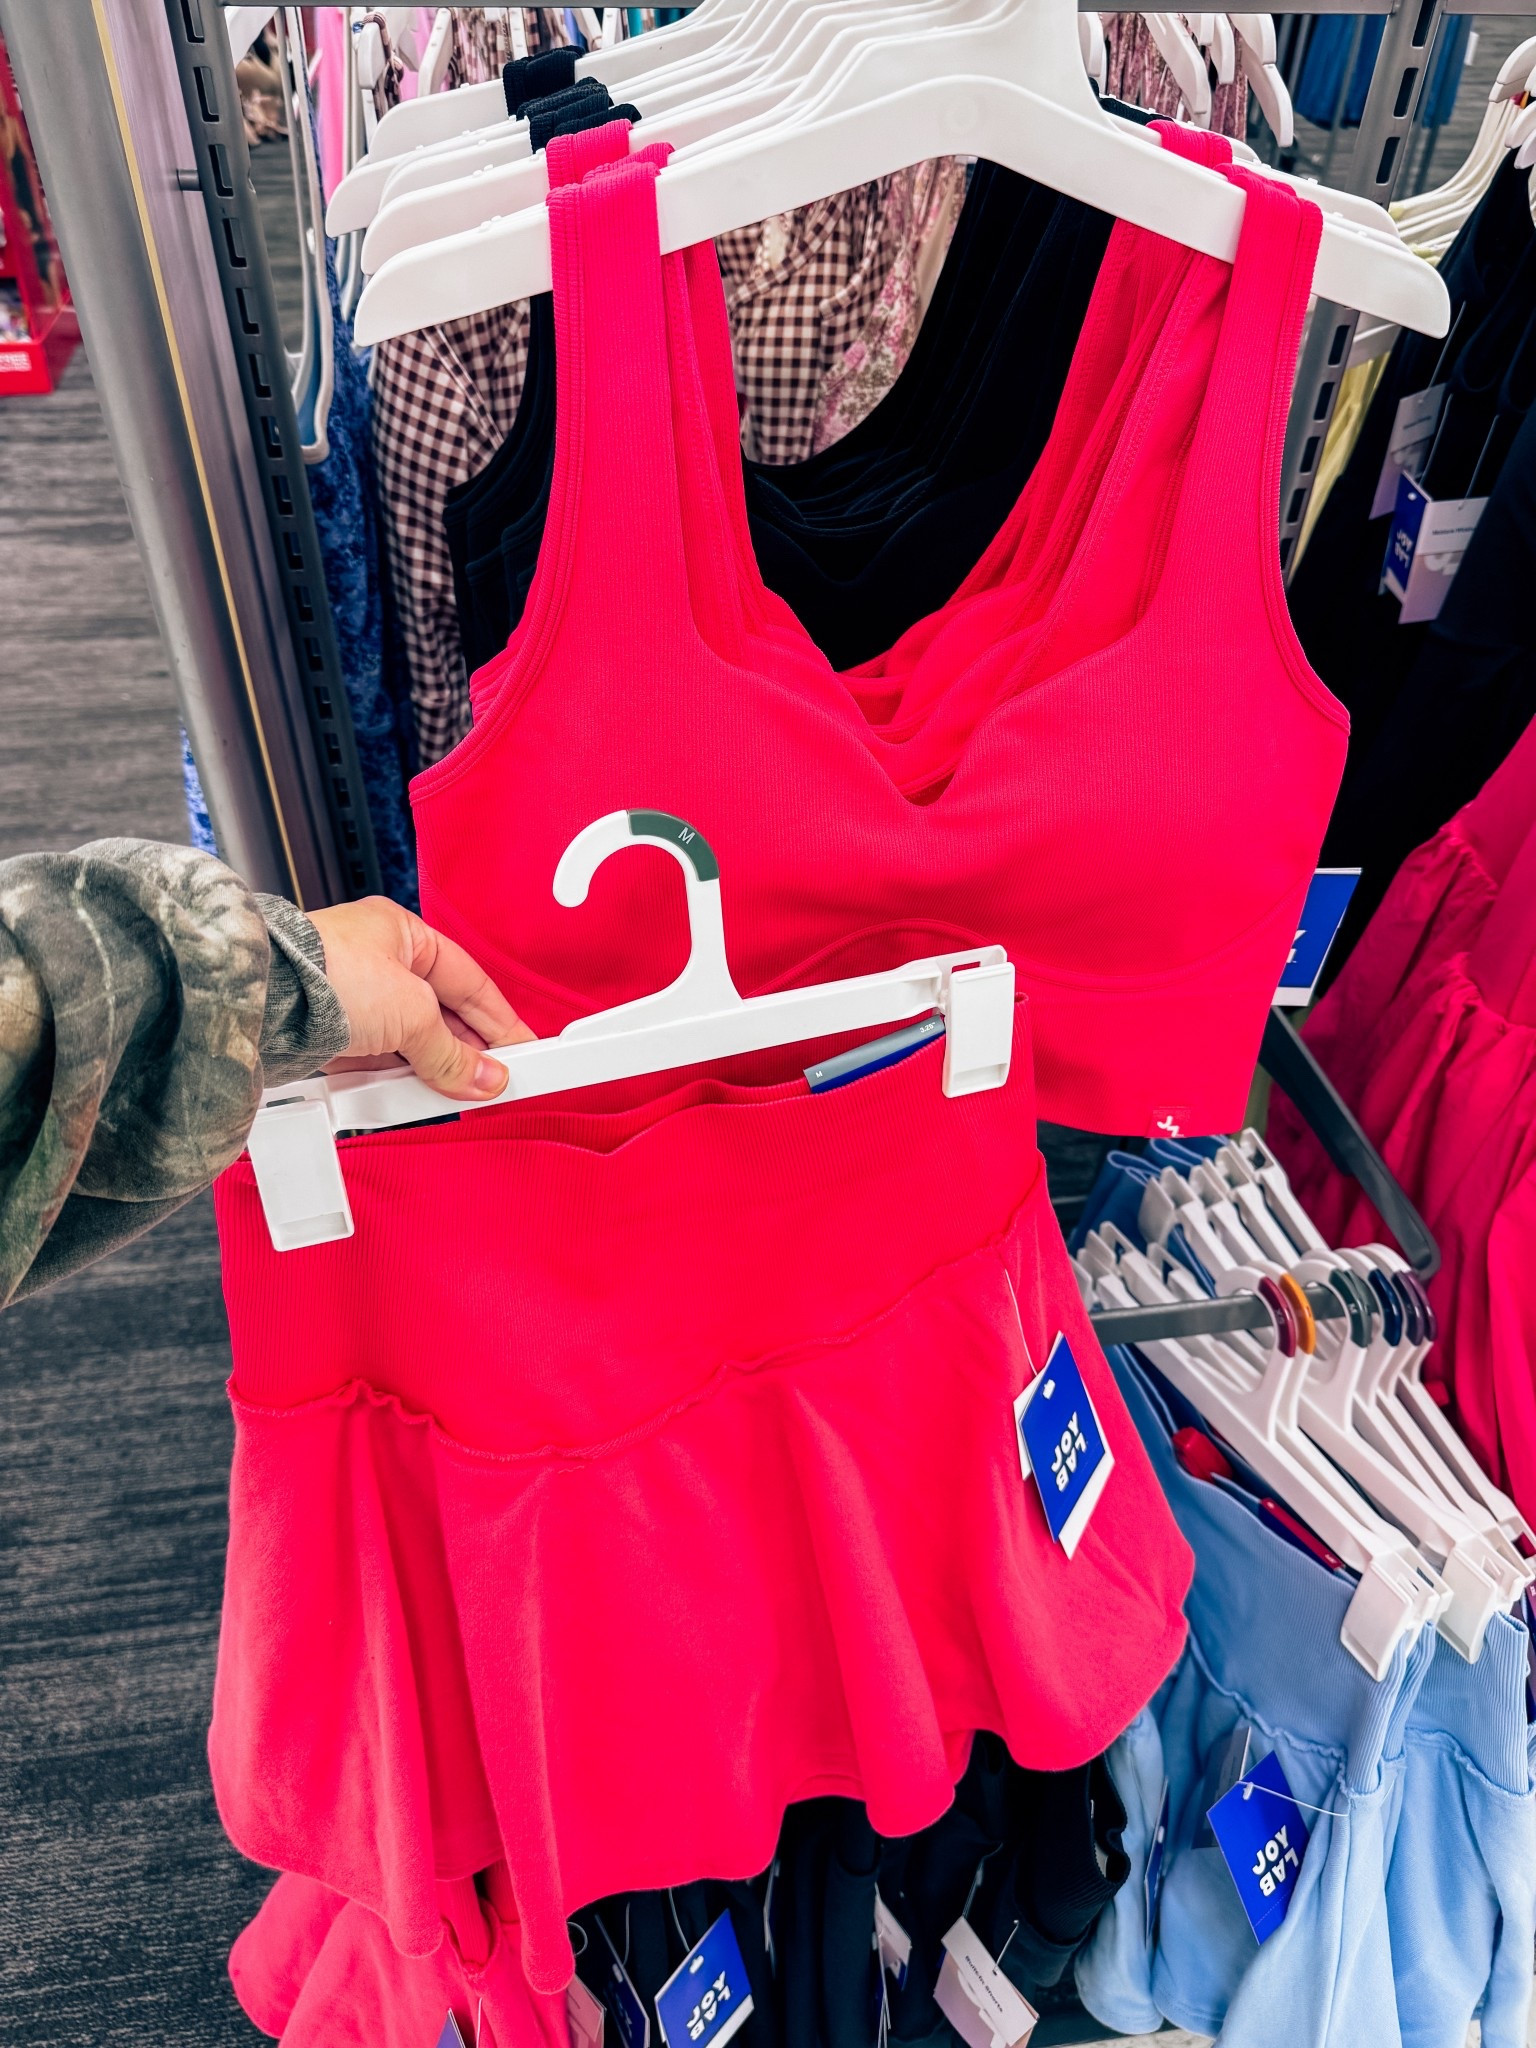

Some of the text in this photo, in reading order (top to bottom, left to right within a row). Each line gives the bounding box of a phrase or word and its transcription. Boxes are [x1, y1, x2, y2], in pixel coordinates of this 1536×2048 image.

[677, 826, 696, 845] M
[815, 1070, 823, 1079] M
[1051, 1411, 1080, 1473] JOY
[1056, 1432, 1087, 1493] LAB
[1252, 1824, 1289, 1875] JOY
[1258, 1847, 1299, 1897] LAB
[686, 1970, 726, 2029] JOY
[689, 1985, 731, 2041] LAB
